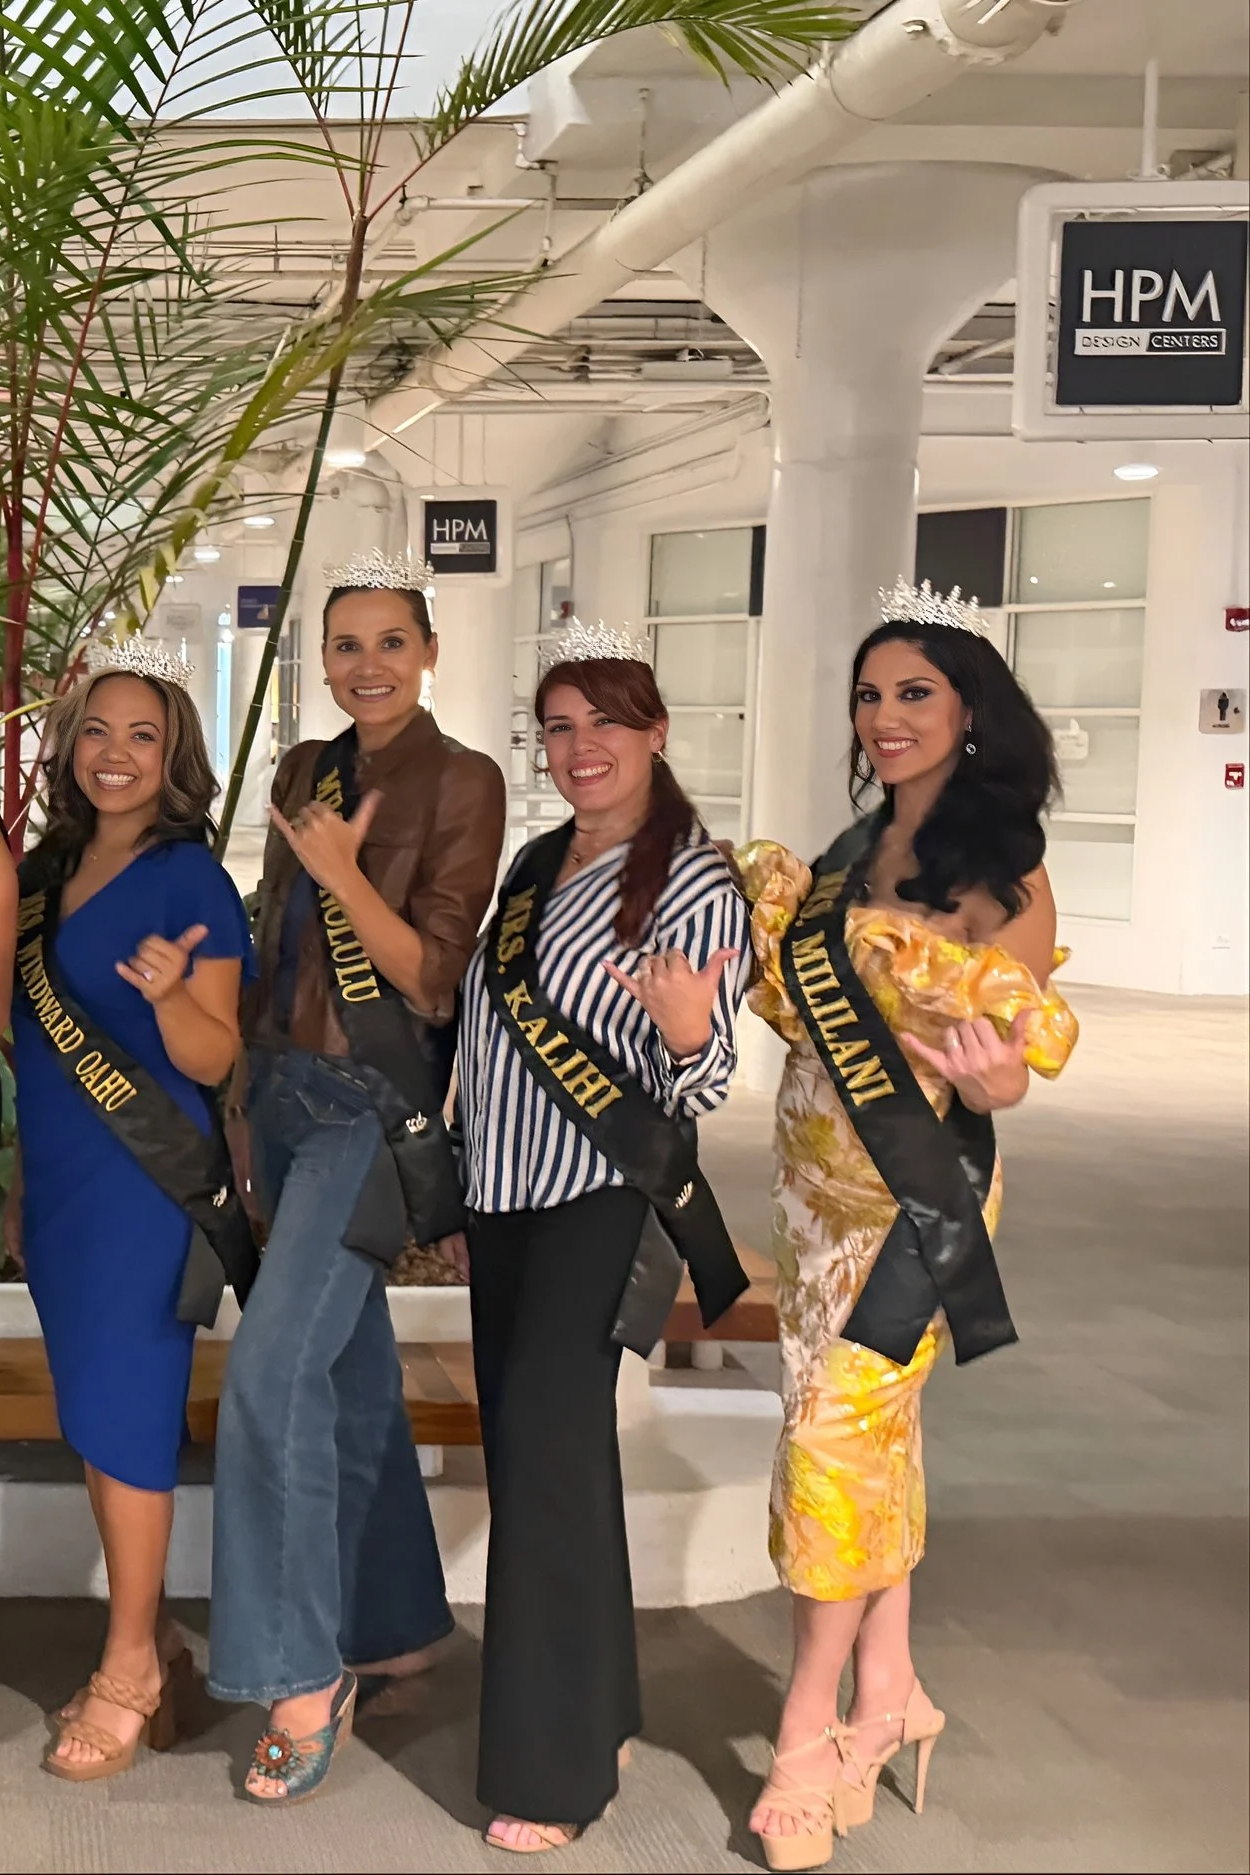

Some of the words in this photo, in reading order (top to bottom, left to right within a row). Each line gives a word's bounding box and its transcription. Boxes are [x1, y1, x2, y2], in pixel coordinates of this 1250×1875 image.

[1082, 268, 1222, 323] HPM
[1081, 336, 1141, 348] DESIGN
[1150, 335, 1219, 349] CENTERS
[433, 518, 488, 541] HPM
[497, 884, 537, 974] MRS.
[17, 934, 85, 1054] WINDWARD
[75, 1051, 138, 1112] OAHU
[504, 980, 623, 1119] KALIHI
[792, 930, 896, 1107] MILILANI
